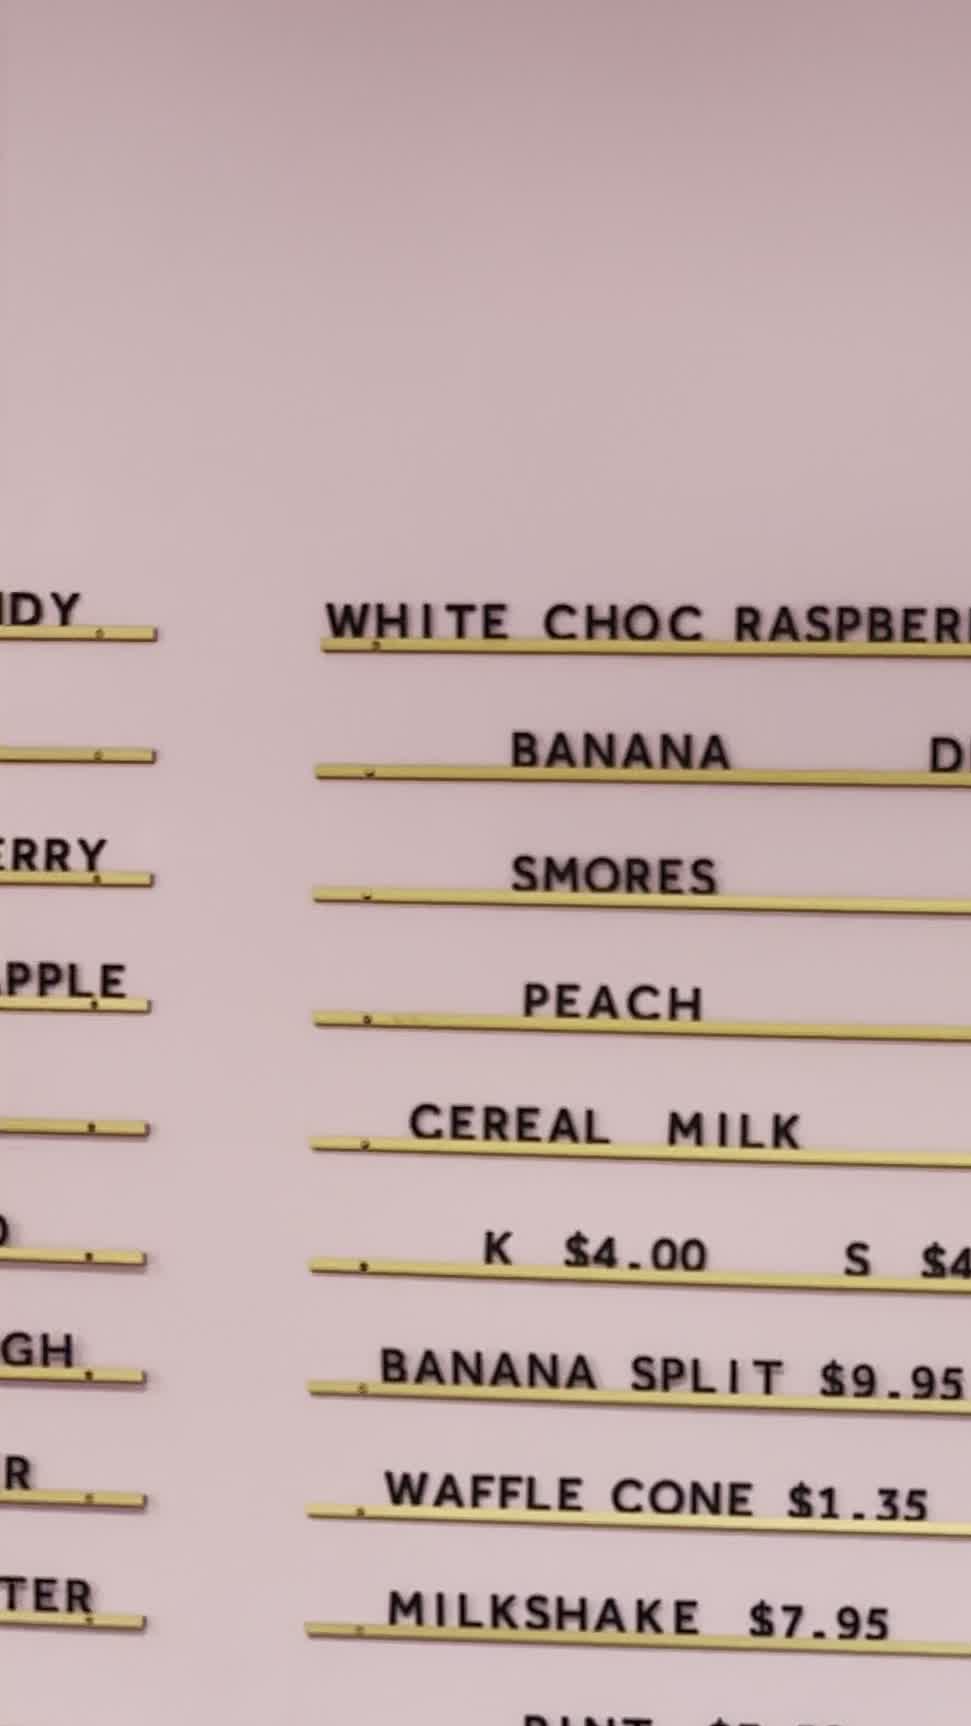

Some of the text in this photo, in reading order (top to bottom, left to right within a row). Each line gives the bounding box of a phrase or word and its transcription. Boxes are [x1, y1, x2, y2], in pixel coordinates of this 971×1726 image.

[0, 591, 80, 627] DY
[326, 603, 508, 640] WHITE
[543, 604, 702, 641] CHOC
[512, 732, 731, 770] BANANA
[0, 837, 106, 872] RRY
[512, 855, 717, 895] SMORES
[0, 961, 125, 998] PPLE
[524, 983, 701, 1021] PEACH
[409, 1104, 799, 1149] CEREAL MILK
[485, 1232, 511, 1265] K
[565, 1232, 707, 1272] $4.00
[845, 1242, 870, 1277] S
[381, 1348, 964, 1401] BANANA SPLIT $9.95
[385, 1471, 927, 1522] WAFFLE CONE $1.35
[388, 1591, 889, 1640] MILKSHAKE $7.95
